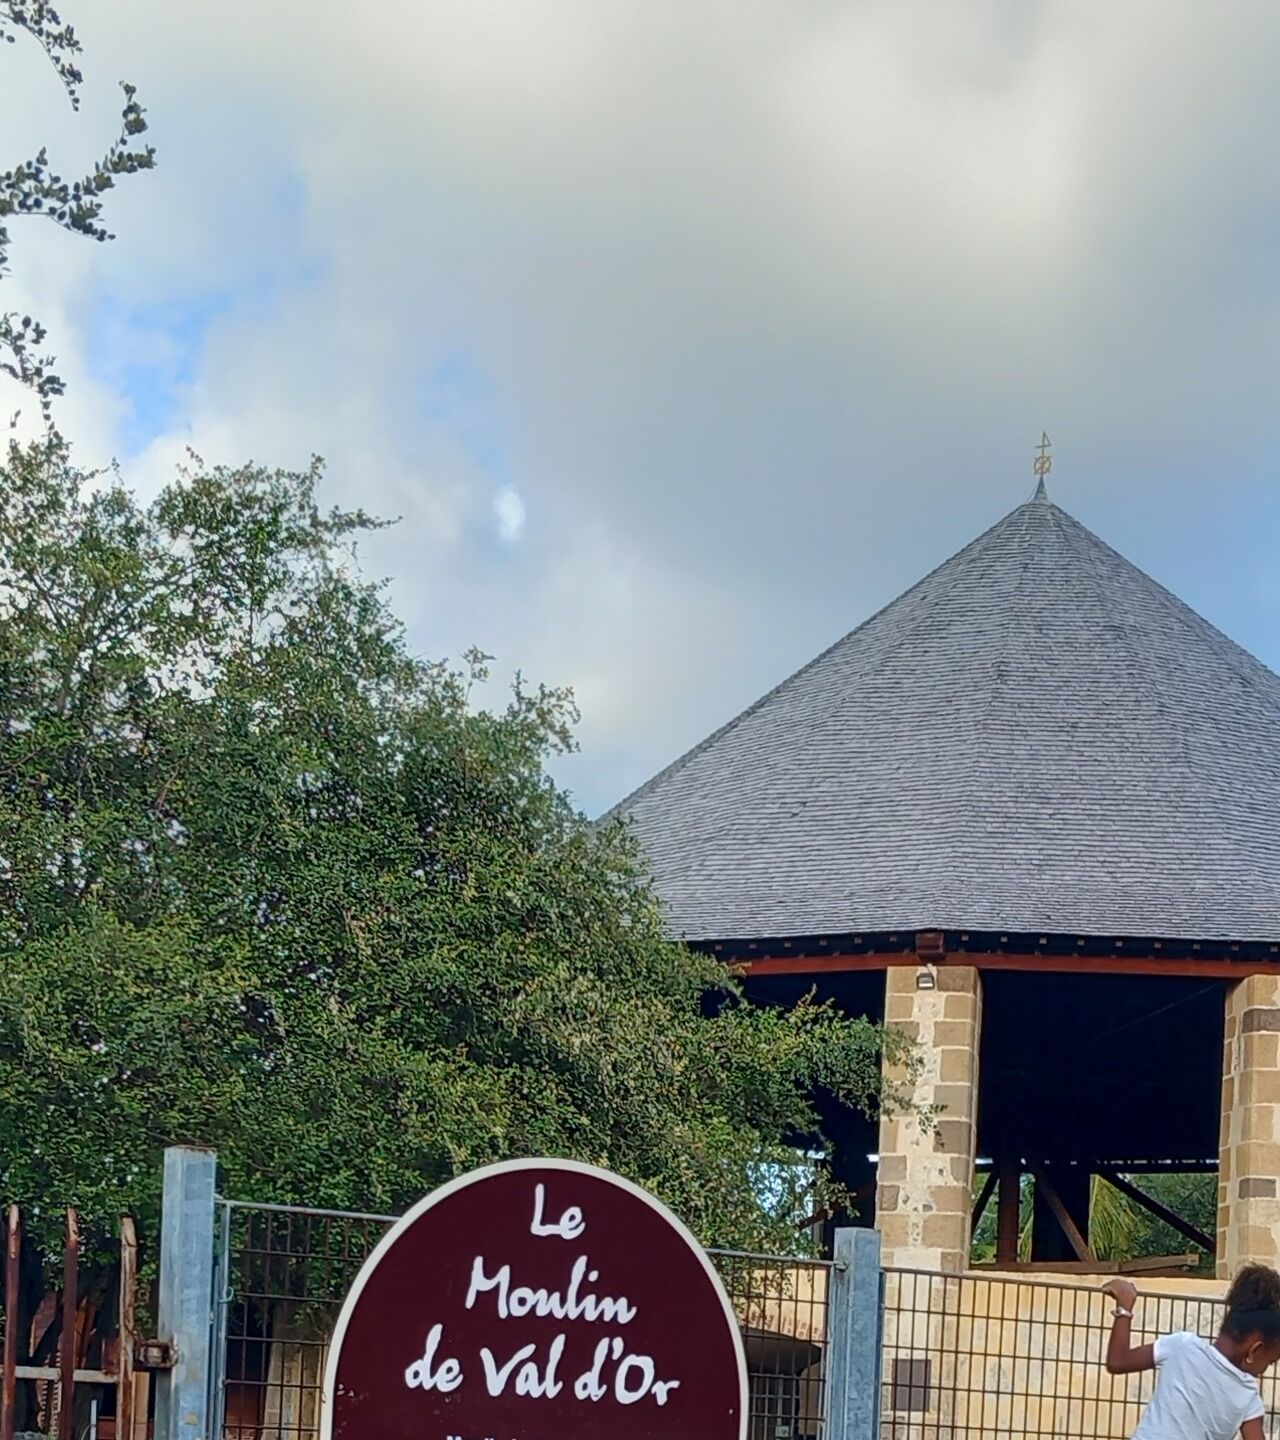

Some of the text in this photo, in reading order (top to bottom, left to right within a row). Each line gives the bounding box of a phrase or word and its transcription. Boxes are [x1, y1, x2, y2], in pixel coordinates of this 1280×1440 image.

[531, 1183, 586, 1240] Le
[465, 1255, 637, 1325] Moulin
[404, 1323, 681, 1406] de Val d'Or
